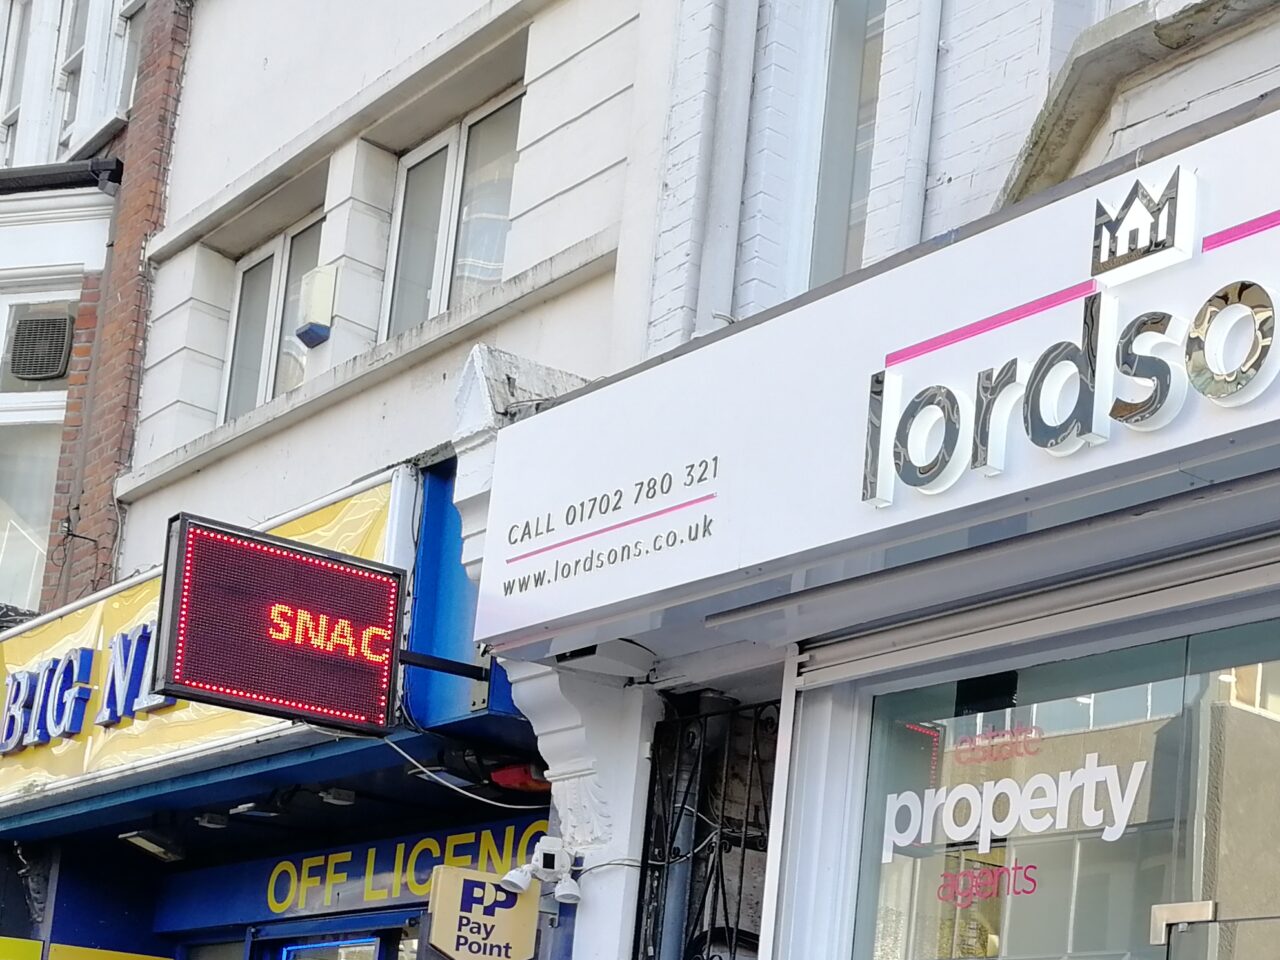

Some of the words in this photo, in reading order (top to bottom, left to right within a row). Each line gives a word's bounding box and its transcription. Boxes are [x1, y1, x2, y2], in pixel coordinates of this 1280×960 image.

[508, 512, 555, 545] CALL
[565, 489, 623, 526] 01702
[633, 472, 673, 504] 780
[683, 456, 718, 487] 321
[503, 514, 713, 596] www.lordsons.co.uk
[268, 603, 391, 662] SNAC
[0, 647, 94, 755] BIG
[953, 720, 1044, 766] estate
[882, 752, 1148, 864] property
[267, 850, 353, 914] OFF
[936, 857, 1038, 909] agents
[455, 935, 513, 959] Point
[457, 915, 496, 941] Pay
